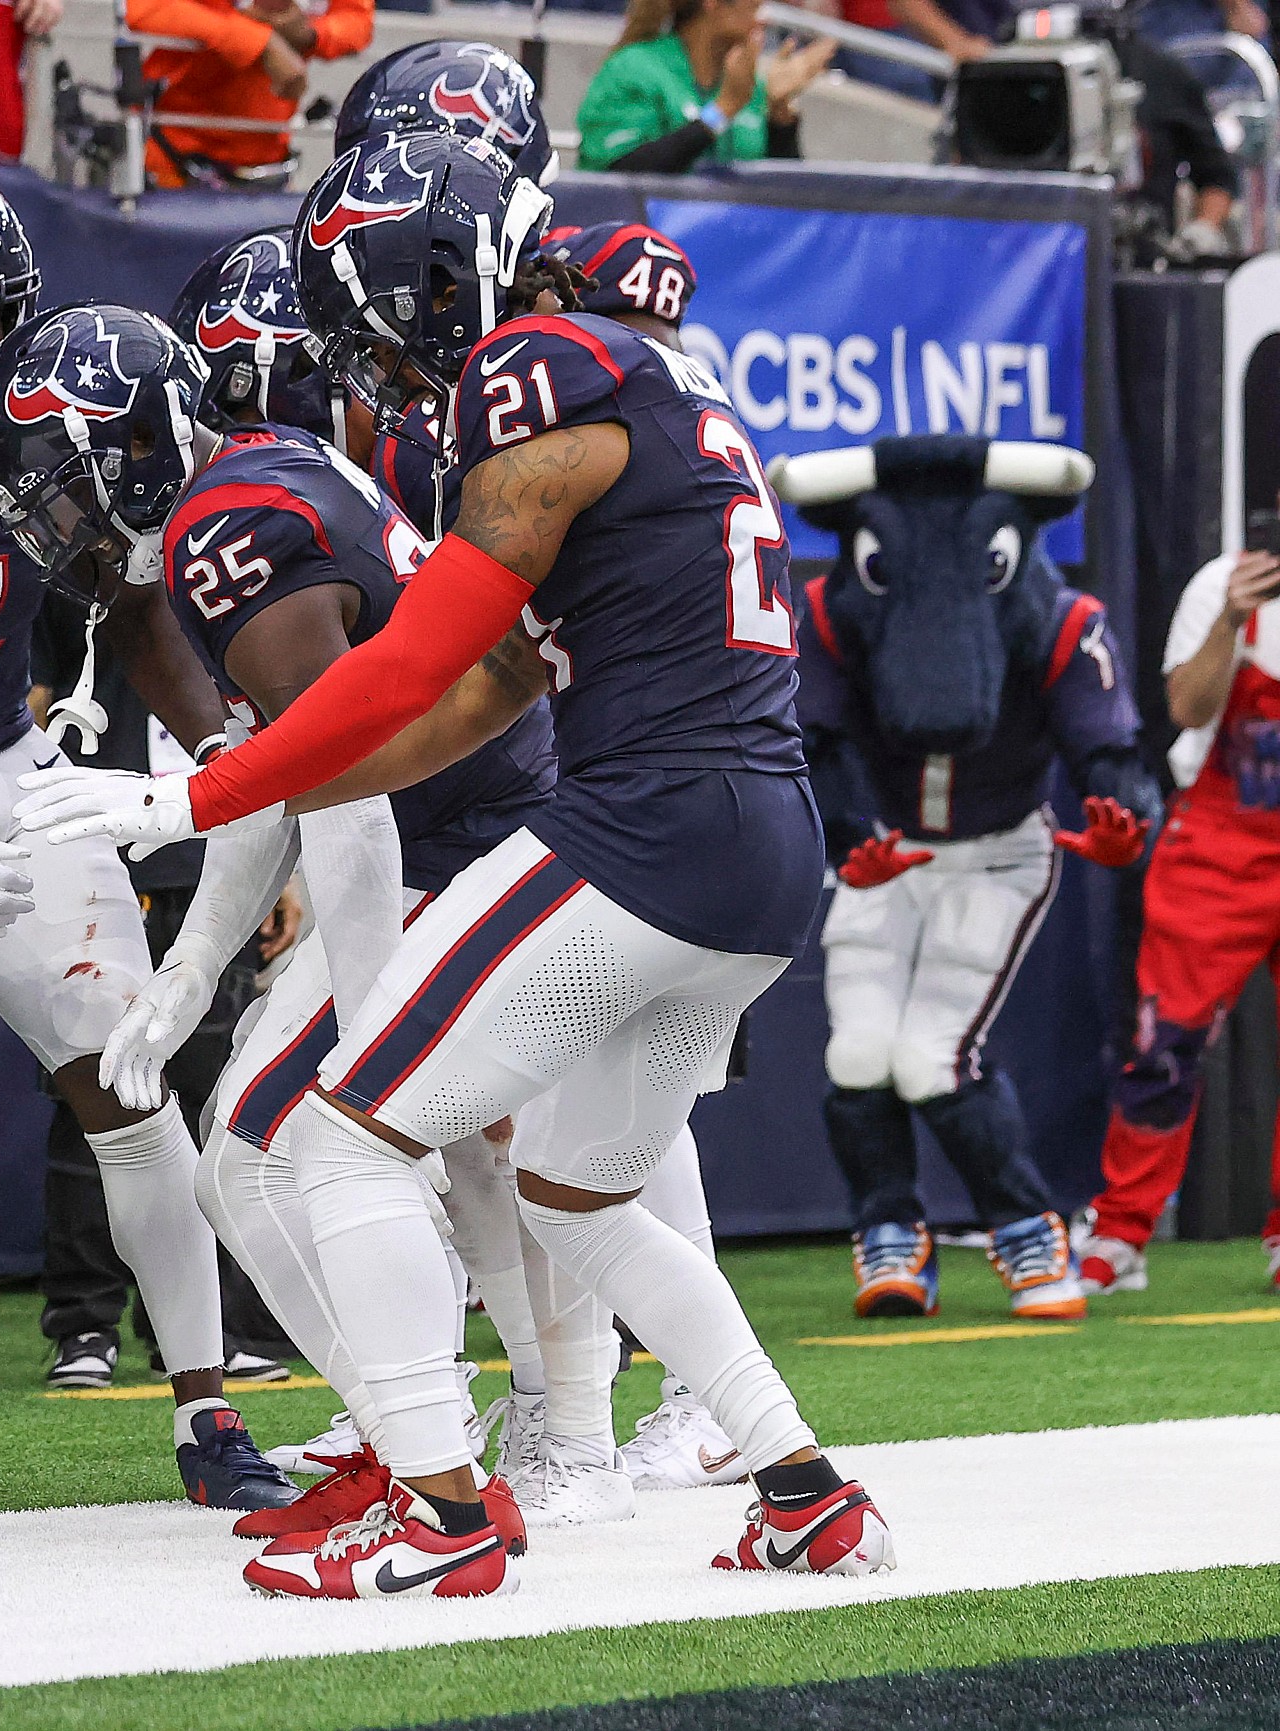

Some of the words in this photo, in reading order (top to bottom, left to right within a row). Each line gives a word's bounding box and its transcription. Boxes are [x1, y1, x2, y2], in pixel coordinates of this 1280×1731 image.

[617, 255, 685, 320] 48
[481, 359, 560, 448] 21
[731, 329, 882, 435] CBS
[921, 339, 1067, 439] NFL
[183, 530, 274, 622] 25
